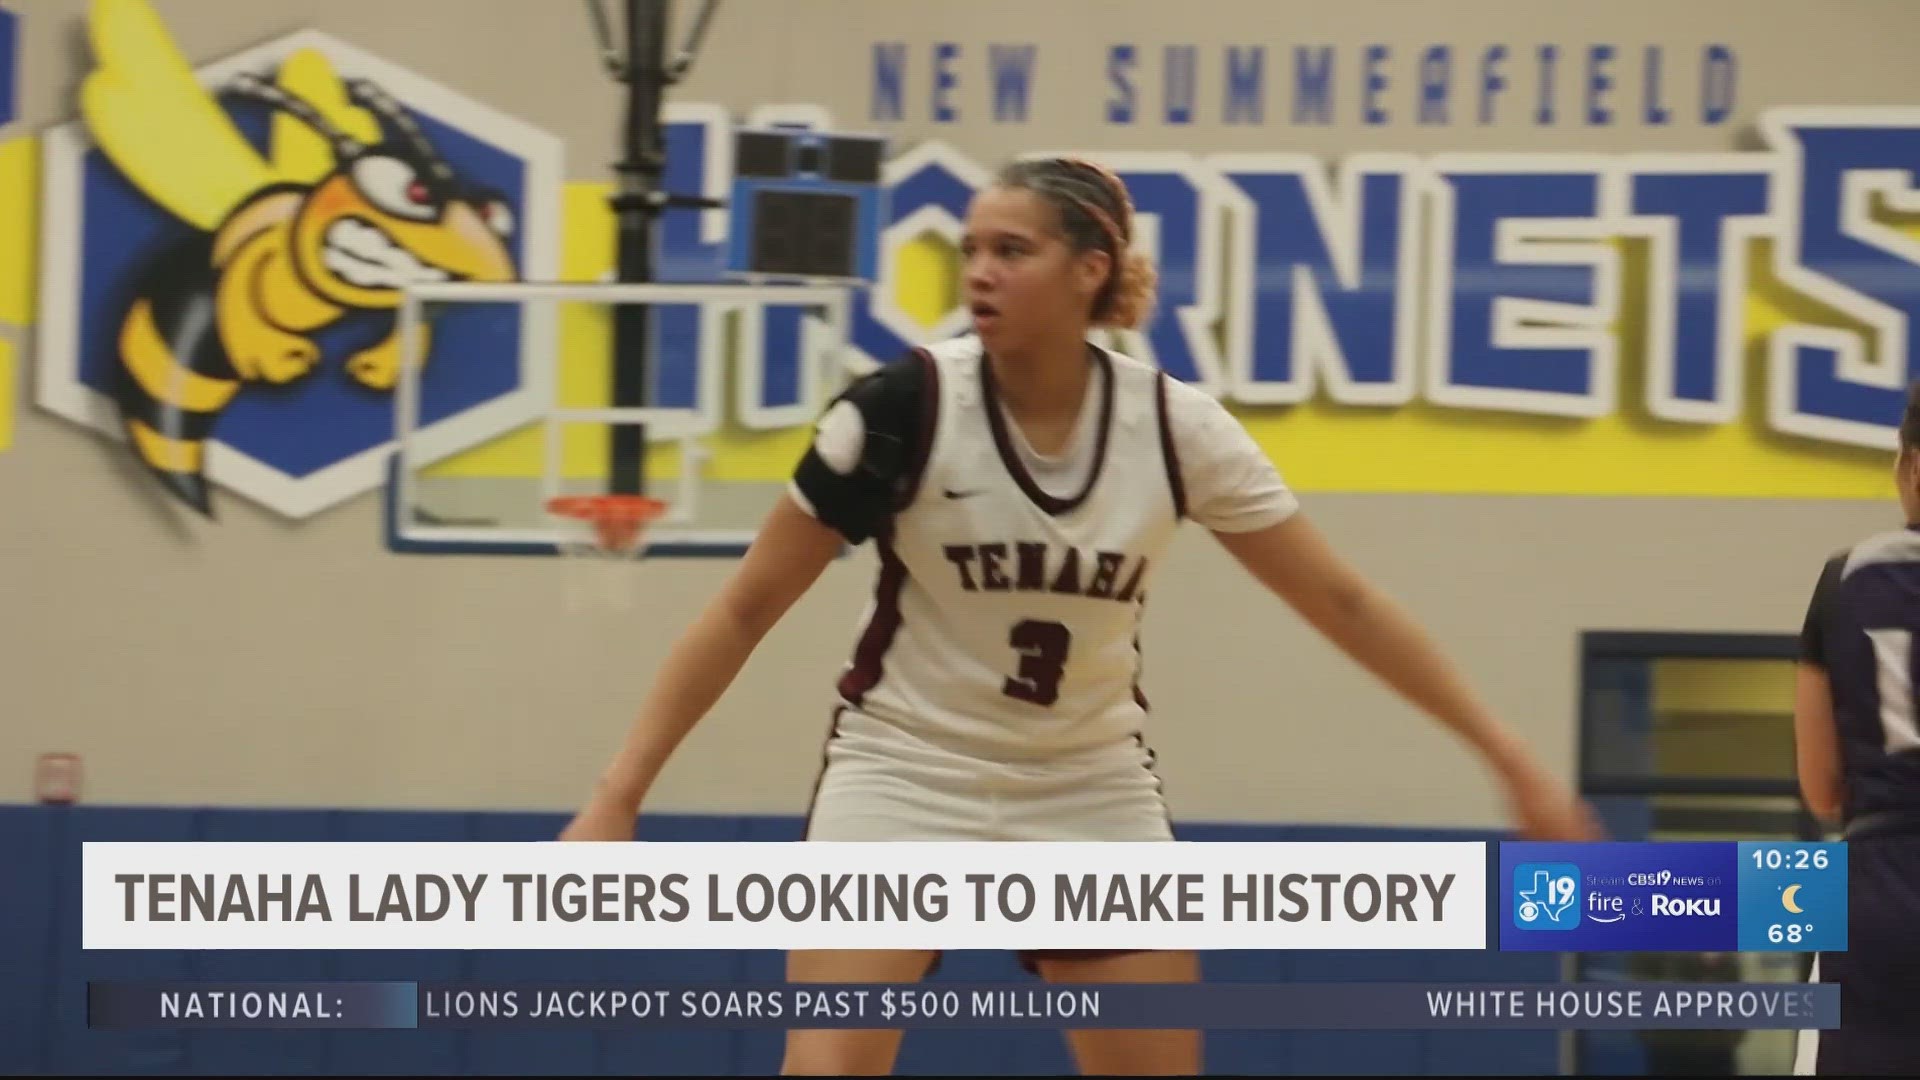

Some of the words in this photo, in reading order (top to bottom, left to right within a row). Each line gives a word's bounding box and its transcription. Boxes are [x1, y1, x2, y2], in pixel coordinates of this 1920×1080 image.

[872, 44, 1036, 123] NEW
[1106, 44, 1740, 125] SUMMERFIELD
[1003, 618, 1073, 708] 3
